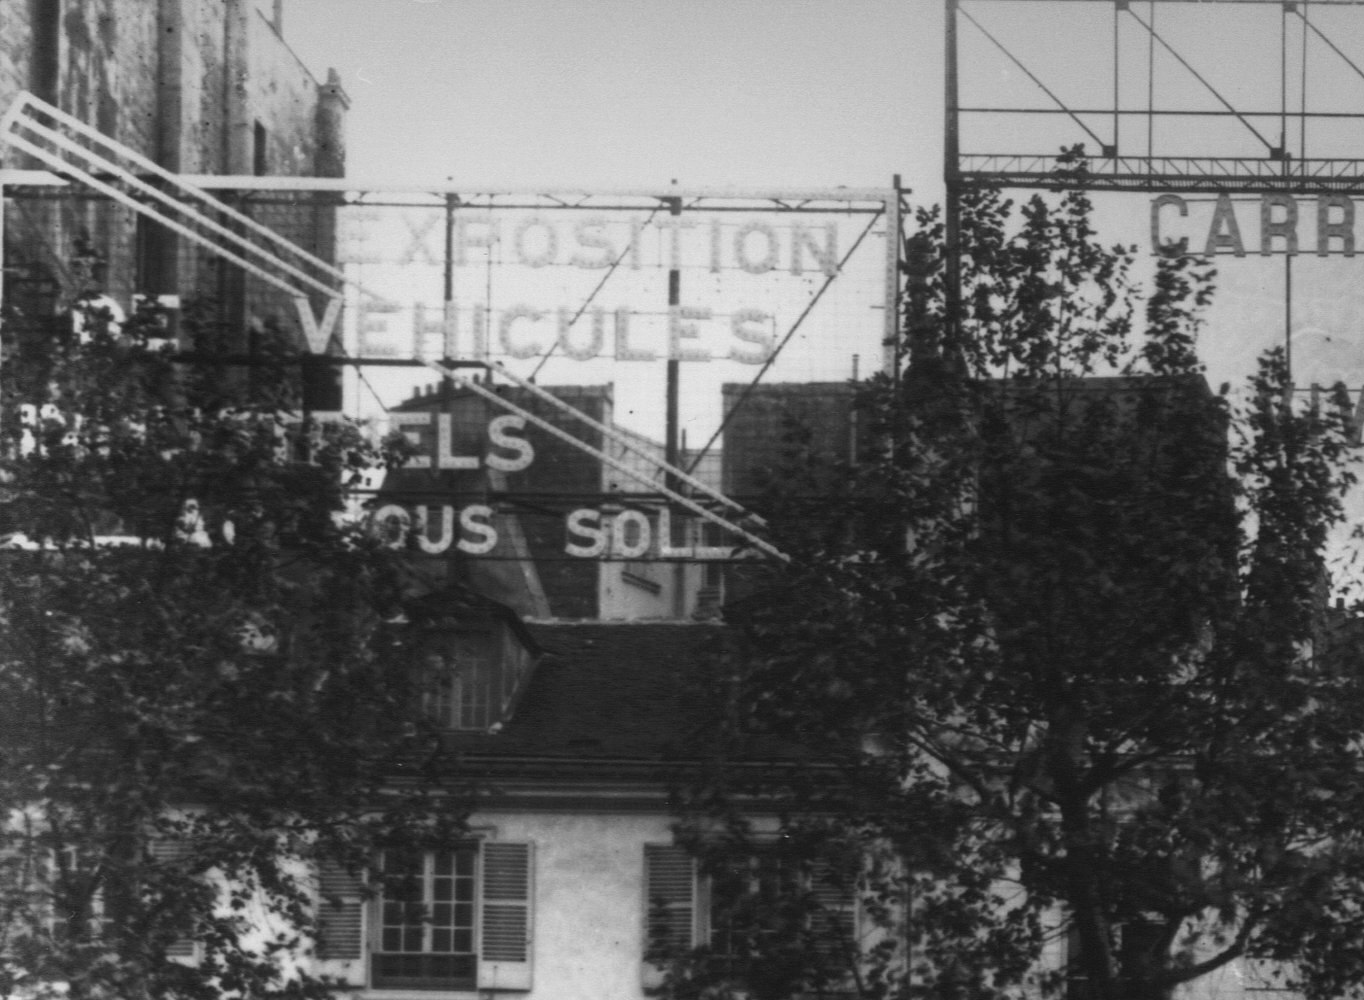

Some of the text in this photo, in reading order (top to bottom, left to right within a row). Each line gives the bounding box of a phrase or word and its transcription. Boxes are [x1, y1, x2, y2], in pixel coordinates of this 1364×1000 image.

[337, 212, 839, 276] EXPOSITION
[296, 297, 777, 365] VEHICULES
[565, 506, 694, 558] SOL
